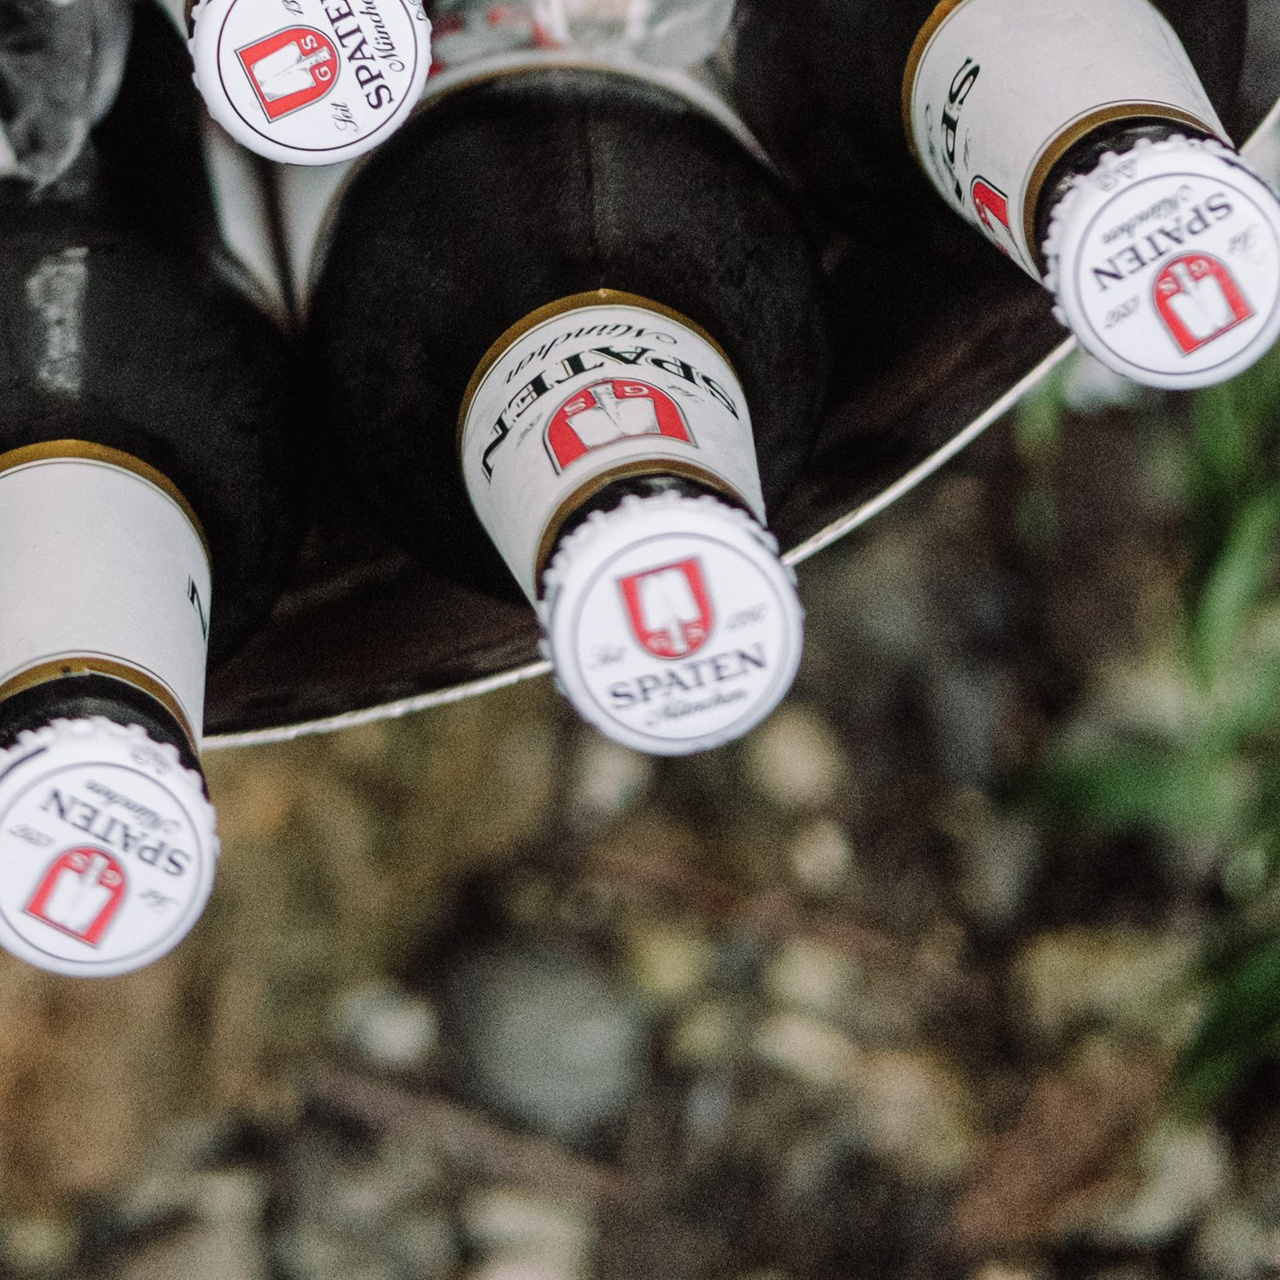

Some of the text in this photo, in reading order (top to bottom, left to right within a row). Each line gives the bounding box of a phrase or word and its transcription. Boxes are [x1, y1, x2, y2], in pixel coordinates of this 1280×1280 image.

[334, 102, 360, 132] Seit
[1093, 192, 1234, 291] SPATEN
[482, 344, 739, 485] SPATEN
[609, 640, 767, 710] SPATEN
[41, 786, 191, 879] SPATEN
